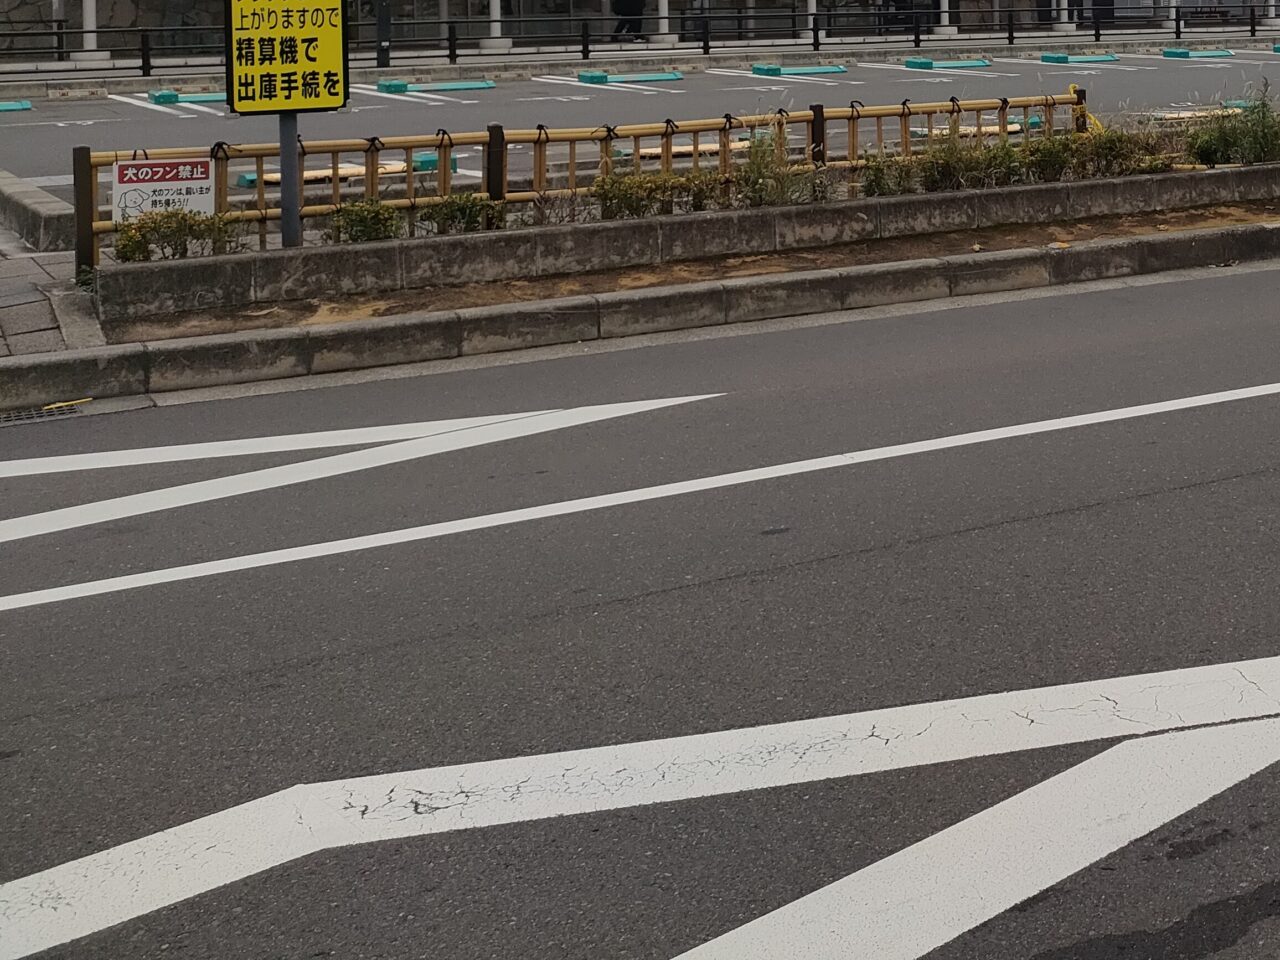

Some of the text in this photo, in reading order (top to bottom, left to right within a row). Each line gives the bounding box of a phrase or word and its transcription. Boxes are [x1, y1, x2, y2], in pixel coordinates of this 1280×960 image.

[235, 7, 340, 31] 上がりますので
[236, 36, 319, 66] 精算機で
[237, 70, 340, 102] 出庫手続を
[123, 165, 206, 181] 犬のフン禁止
